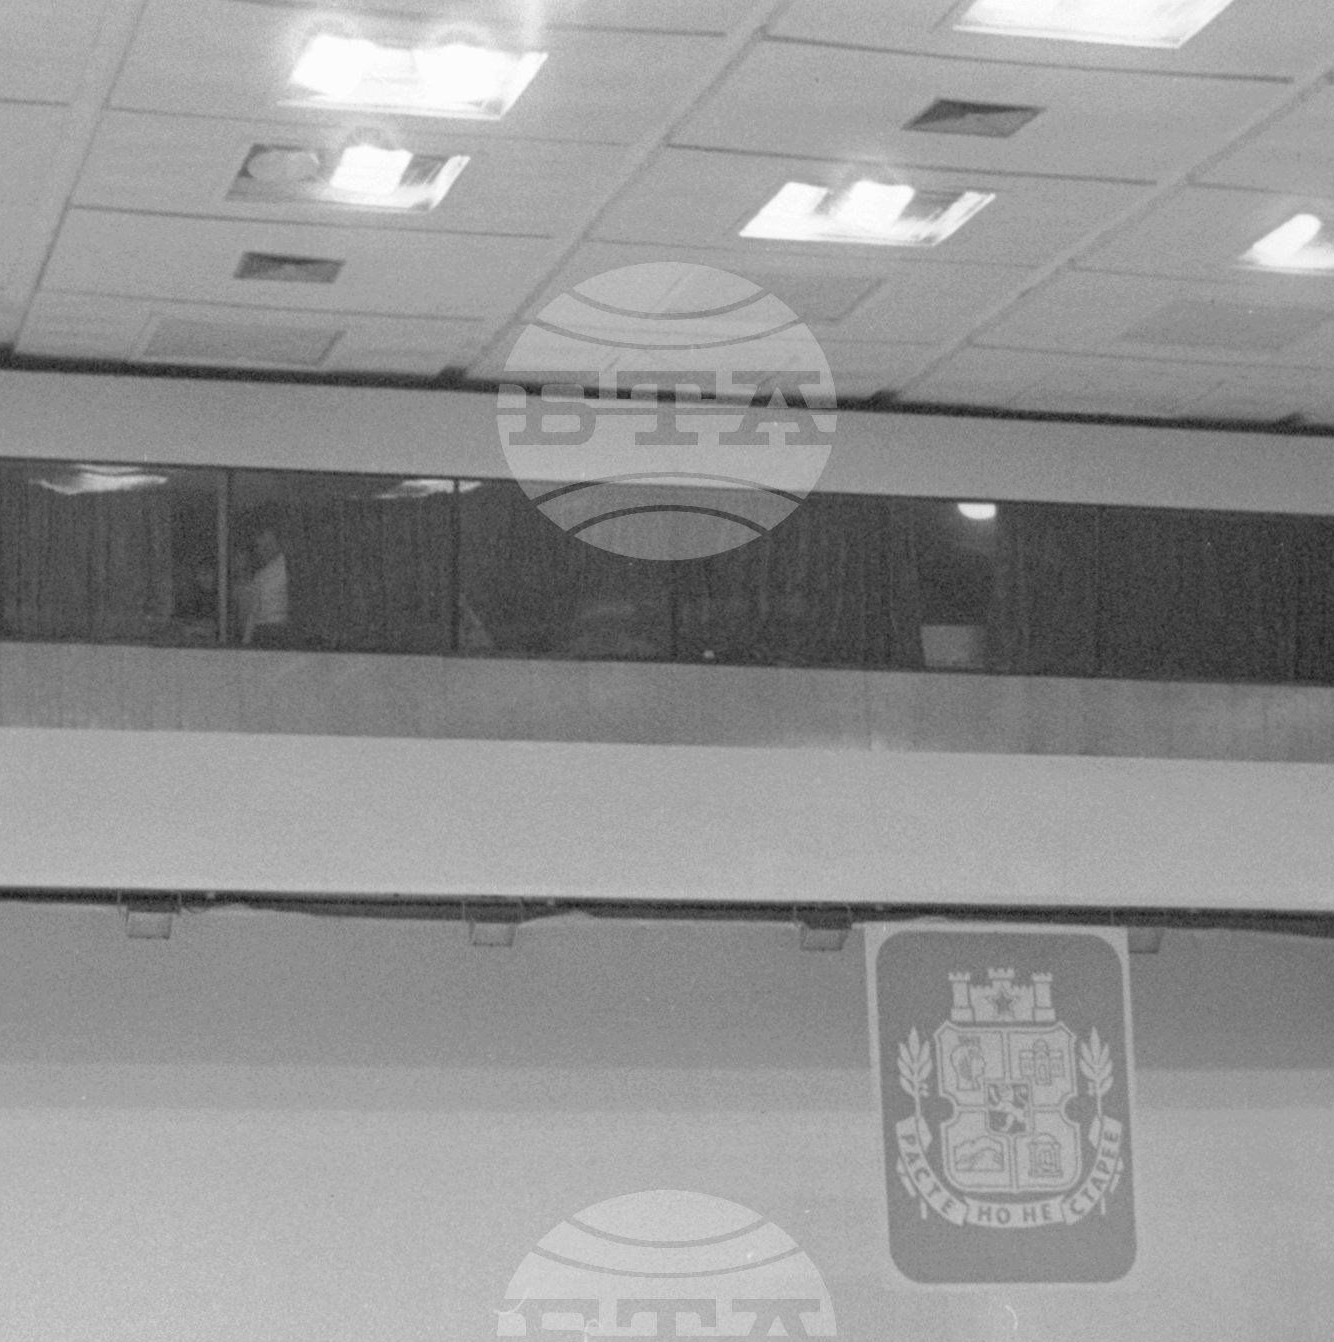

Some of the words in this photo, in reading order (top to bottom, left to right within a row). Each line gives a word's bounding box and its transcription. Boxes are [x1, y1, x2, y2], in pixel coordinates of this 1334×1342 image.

[900, 1133, 956, 1214] РАСТЕ
[977, 1205, 1011, 1224] НО
[1022, 1203, 1052, 1222] НЕ
[1069, 1130, 1119, 1215] СТАРЕЕ
